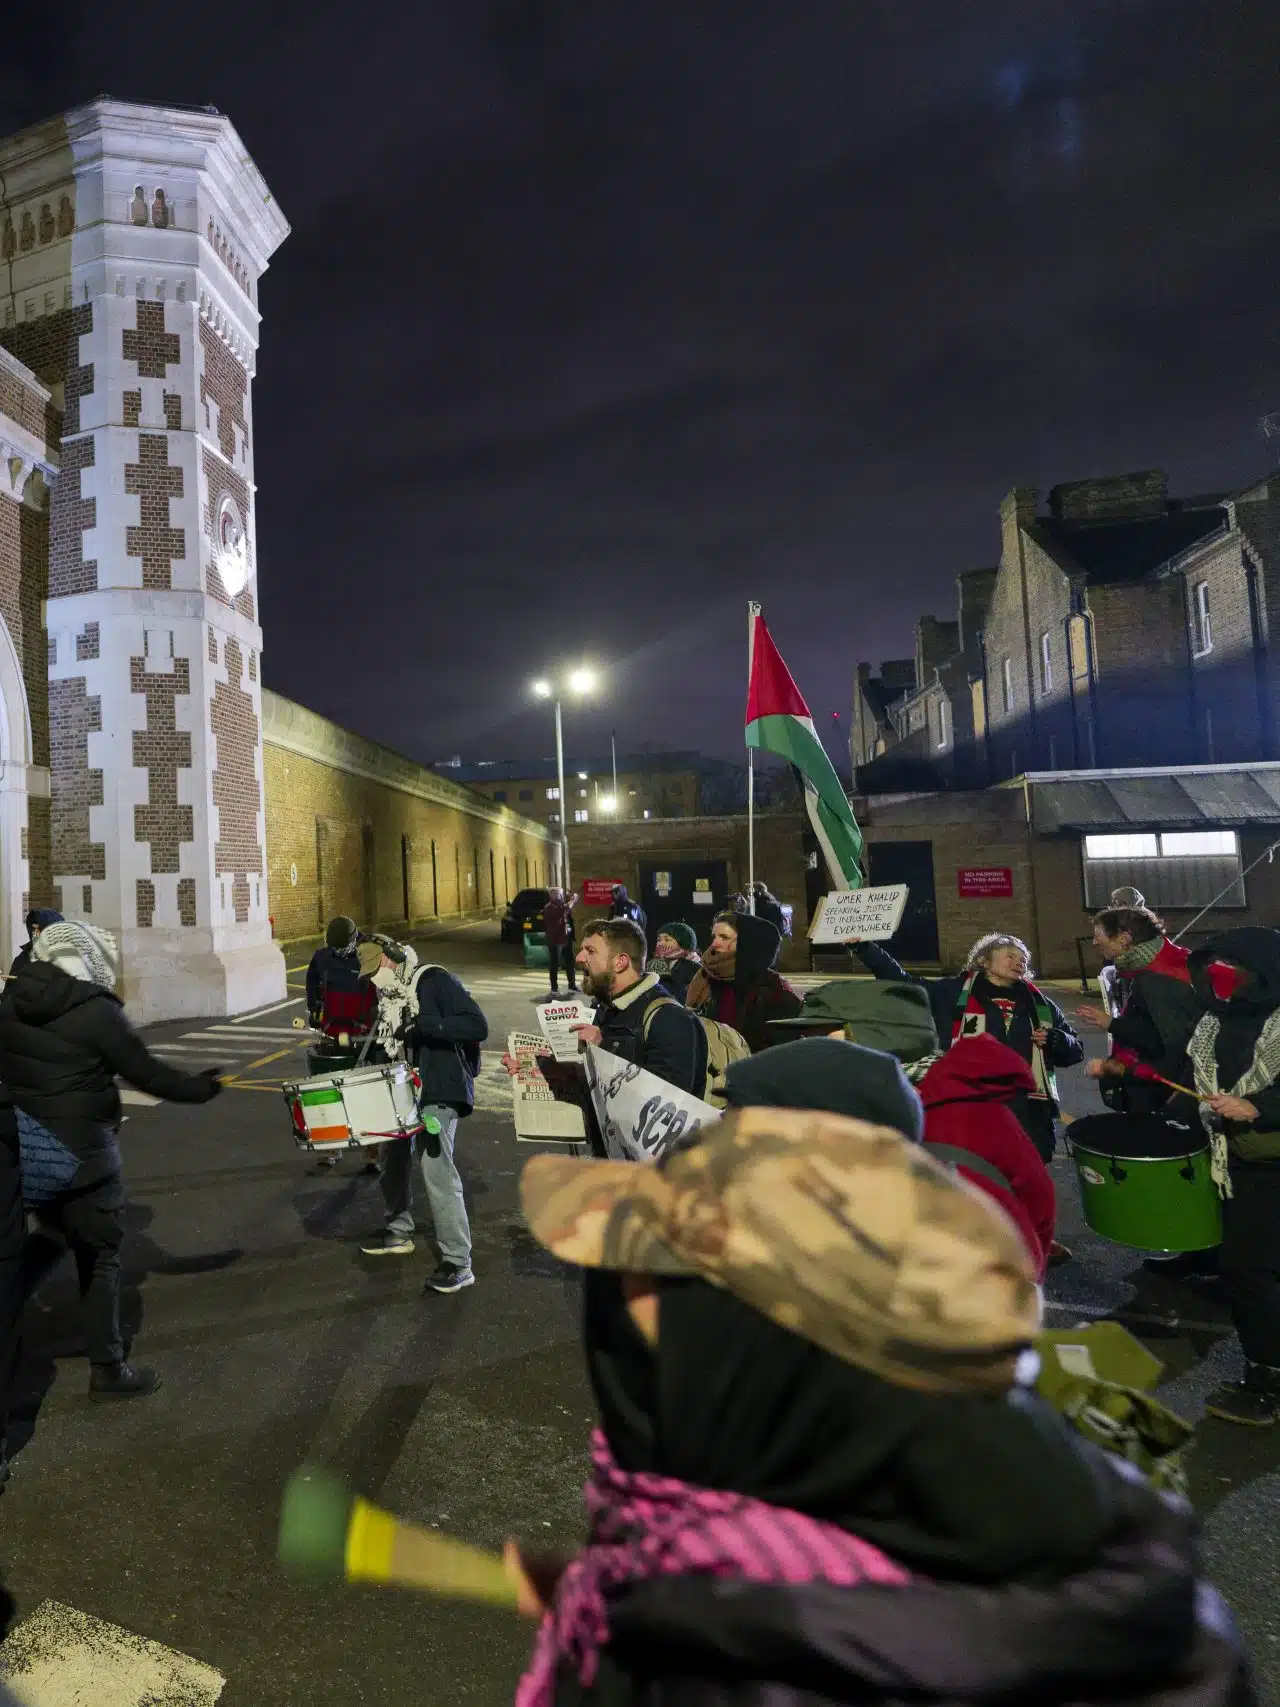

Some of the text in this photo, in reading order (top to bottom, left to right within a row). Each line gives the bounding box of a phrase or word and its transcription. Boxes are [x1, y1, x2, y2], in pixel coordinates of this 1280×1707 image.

[867, 891, 900, 902] KHALID
[825, 903, 893, 915] SPEAKING JUSTICE
[839, 913, 882, 923] INJUSTICE
[833, 922, 892, 935] EVERYWHERE
